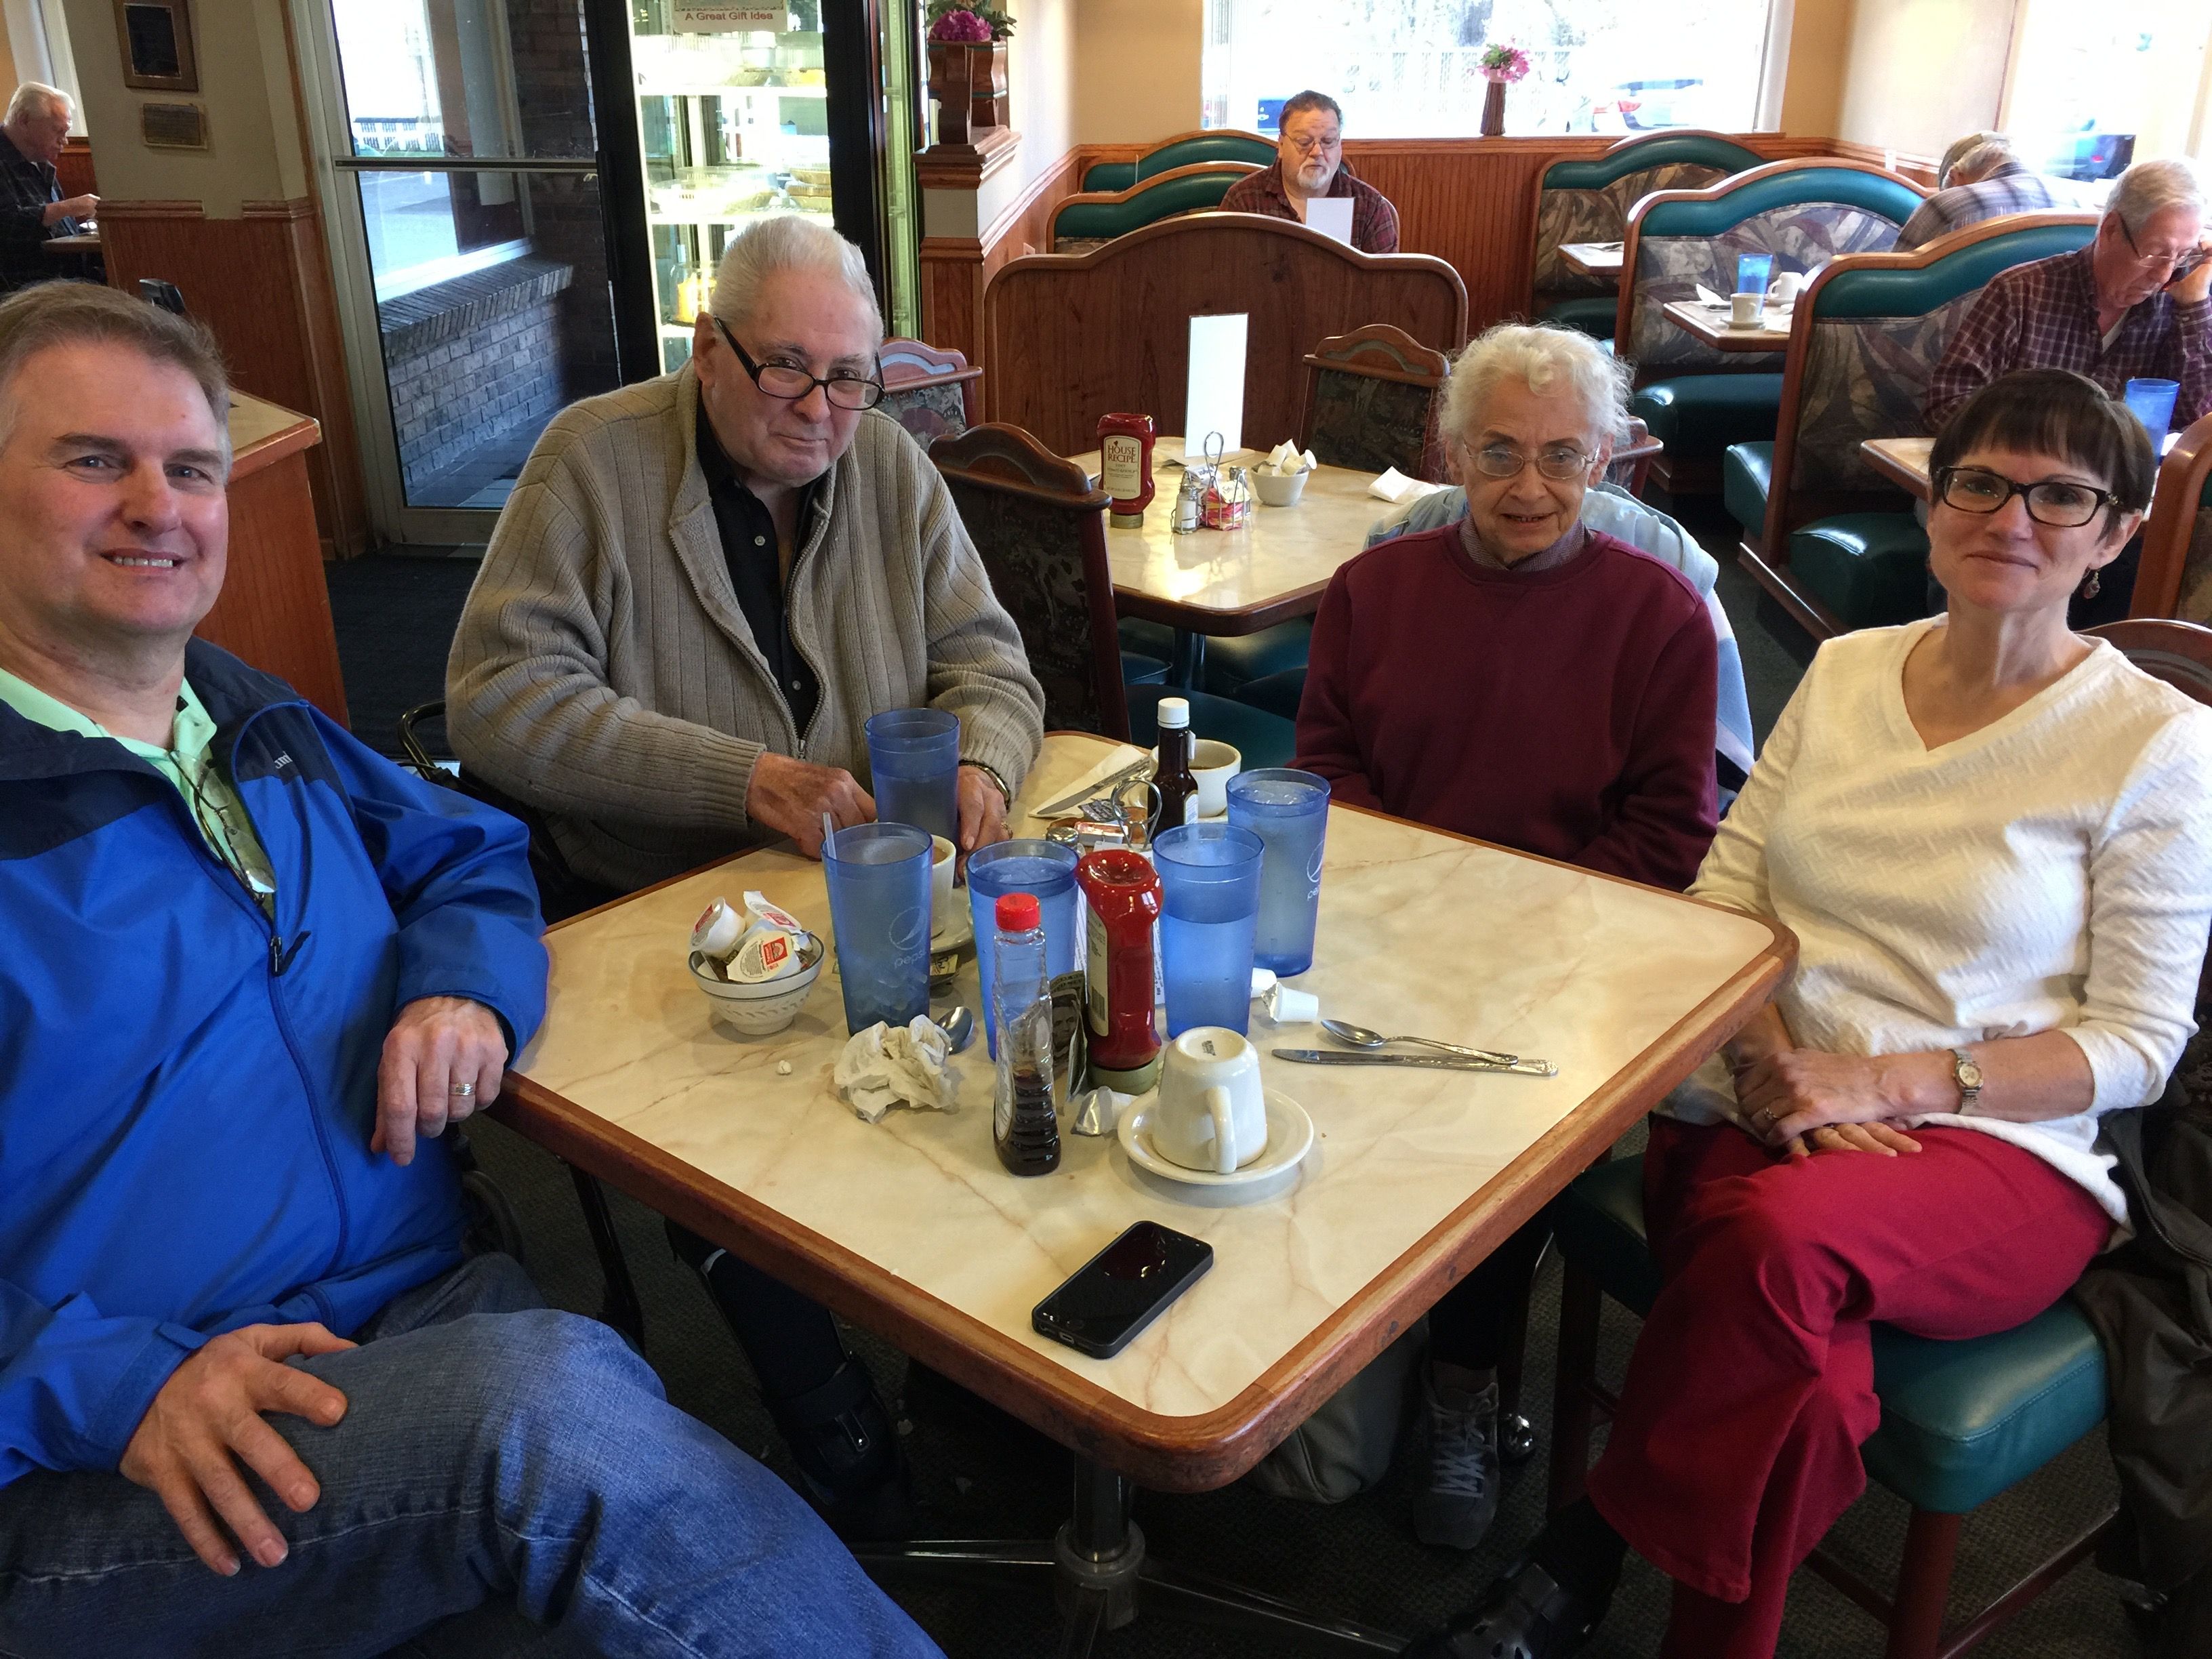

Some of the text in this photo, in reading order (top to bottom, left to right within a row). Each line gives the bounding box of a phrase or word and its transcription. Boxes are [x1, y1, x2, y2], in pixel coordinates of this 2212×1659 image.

[696, 12, 726, 20] Great
[729, 12, 747, 20] Gift
[750, 12, 773, 20] Idea
[1107, 445, 1136, 455] HOUSE
[1107, 454, 1136, 463] RECIPE
